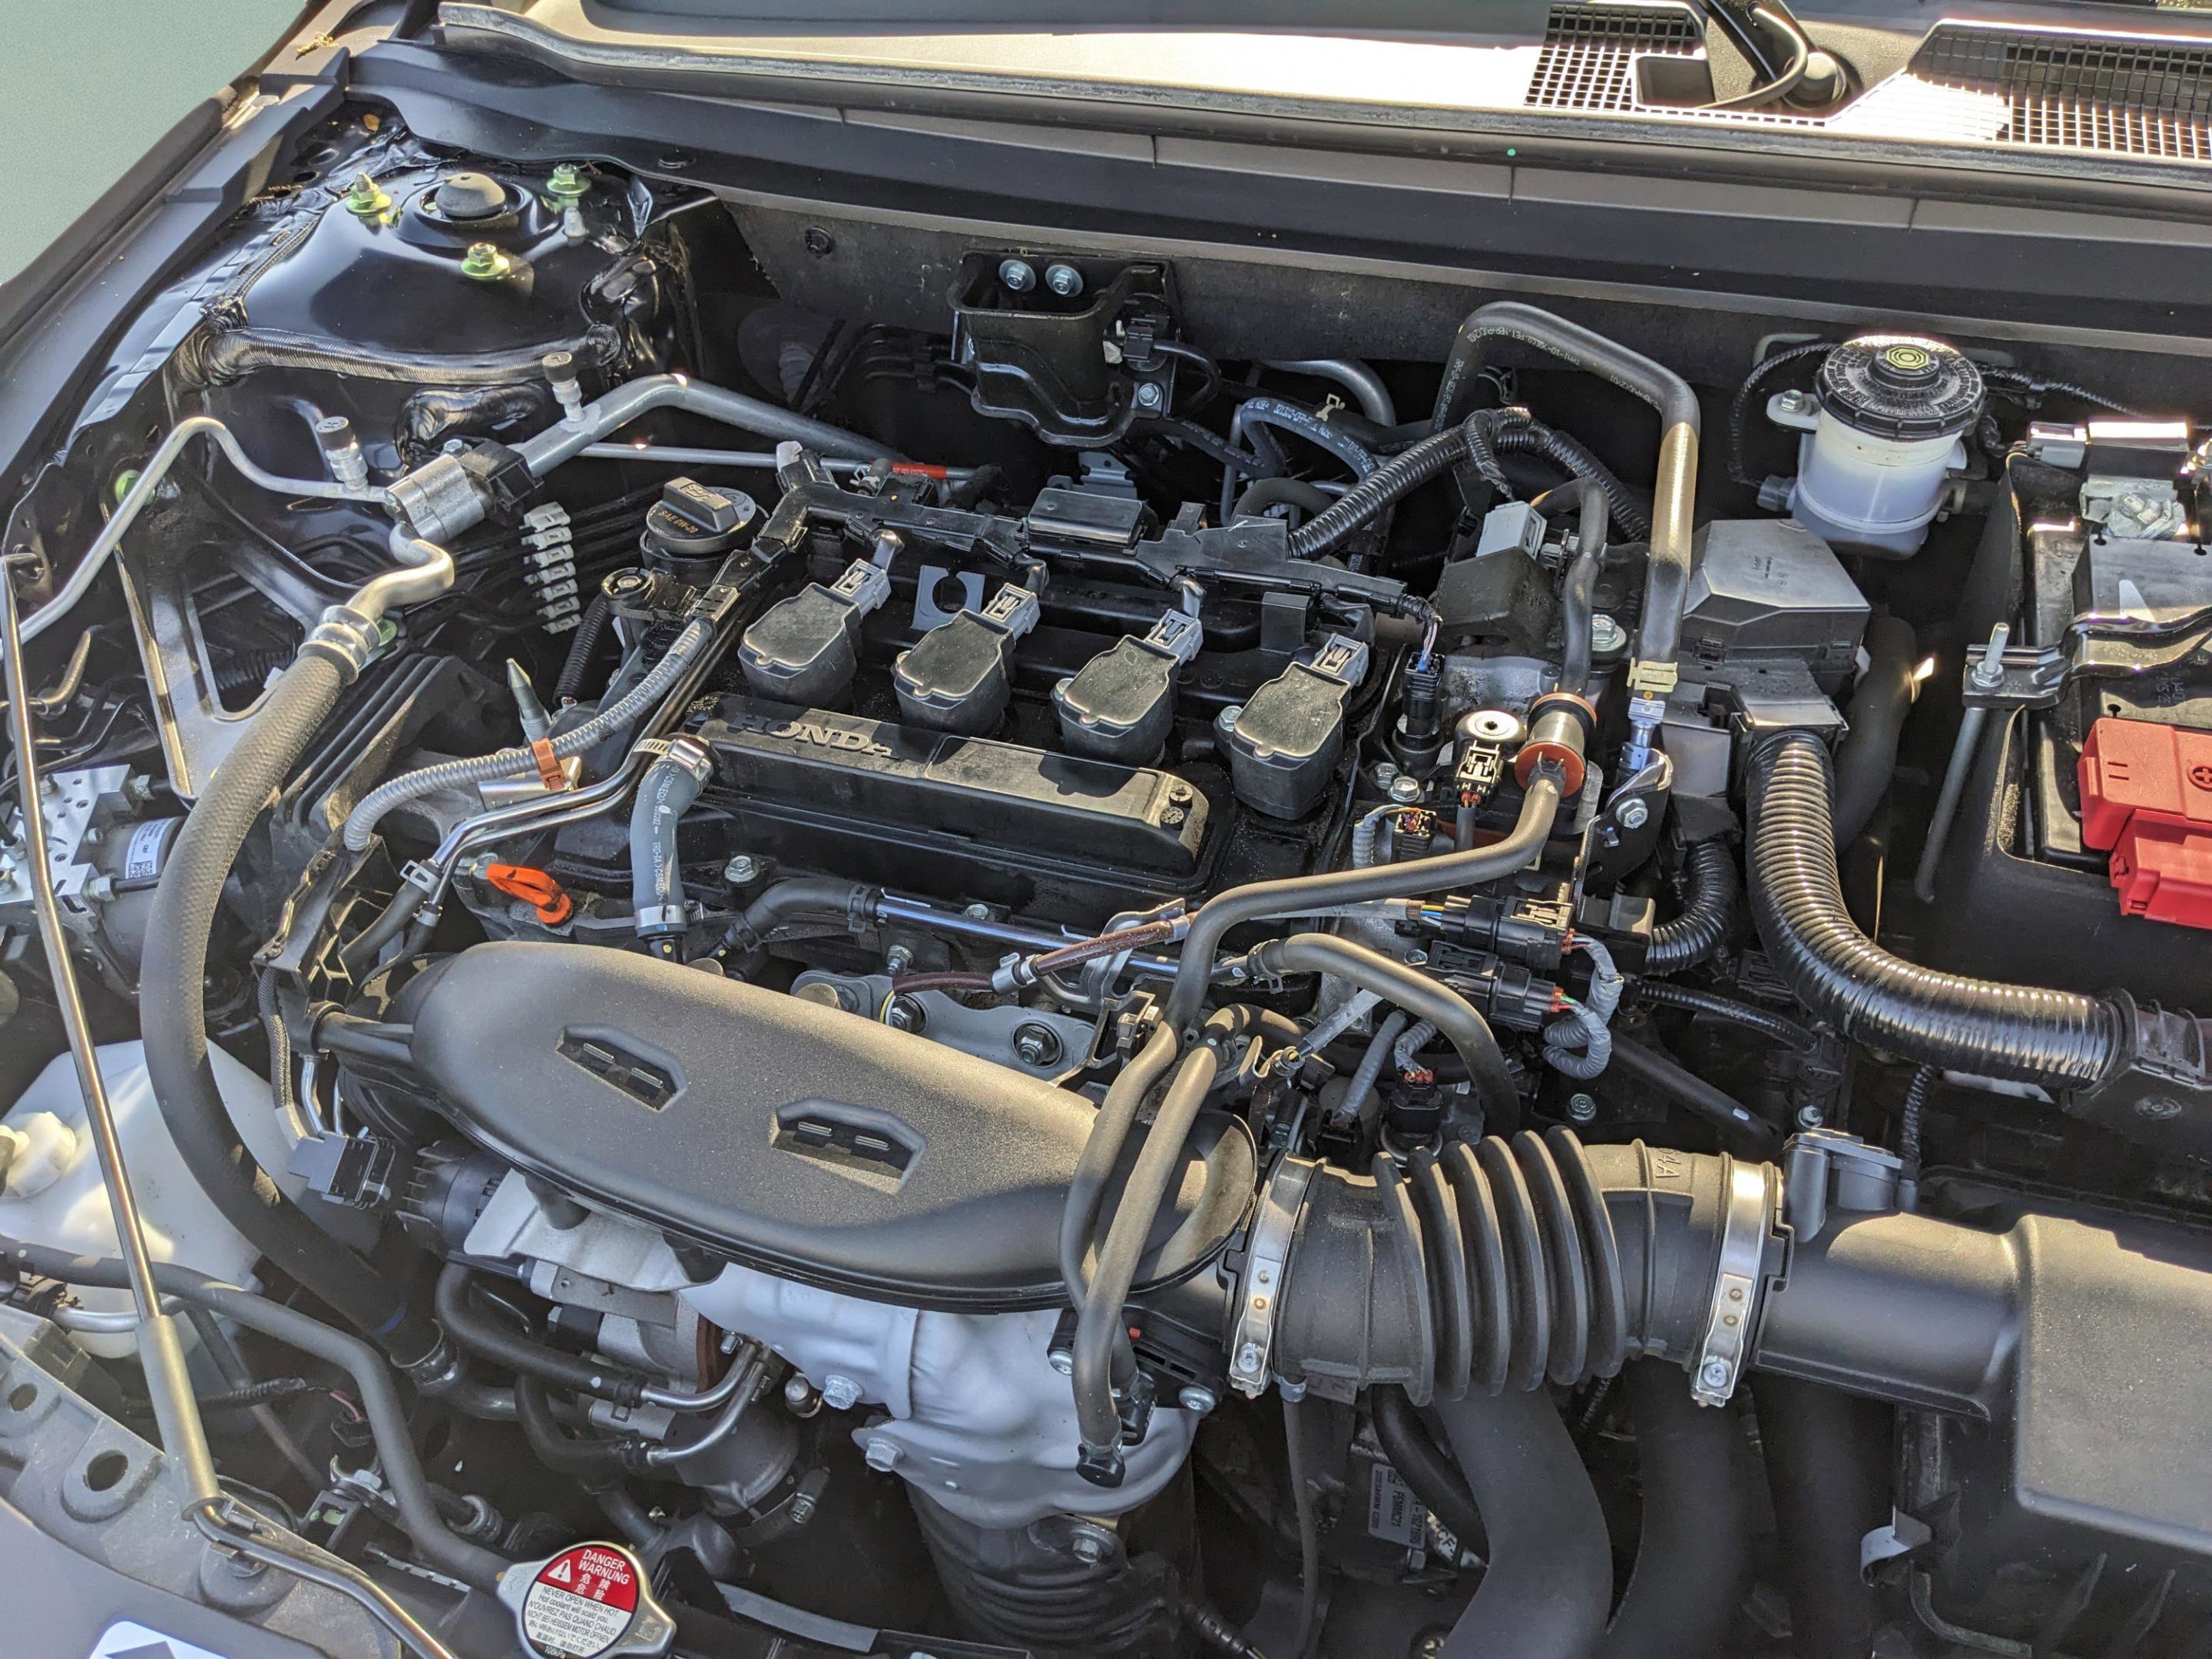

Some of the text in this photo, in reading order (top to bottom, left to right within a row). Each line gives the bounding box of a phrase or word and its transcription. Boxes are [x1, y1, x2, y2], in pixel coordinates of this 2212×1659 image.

[659, 510, 699, 534] SAE 0W-20
[727, 713, 899, 760] HONDA
[578, 1559, 630, 1584] WARNUNG
[582, 1549, 626, 1571] DANGER
[538, 1594, 549, 1603] Hot
[549, 1598, 571, 1610] coolant
[571, 1604, 581, 1613] will
[581, 1608, 597, 1619] scald
[543, 1586, 565, 1598] NEVER
[565, 1593, 584, 1605] OPEN
[584, 1599, 603, 1612] WHEN
[527, 1609, 540, 1620] NICHT
[541, 1613, 550, 1623] BEI
[550, 1616, 573, 1629] HEISSEM
[573, 1623, 591, 1637] MOTOR
[528, 1601, 560, 1615] N'OUVREZ
[559, 1610, 572, 1621] PAS
[572, 1614, 594, 1628] QUAND
[544, 1645, 566, 1659] 108kPa
